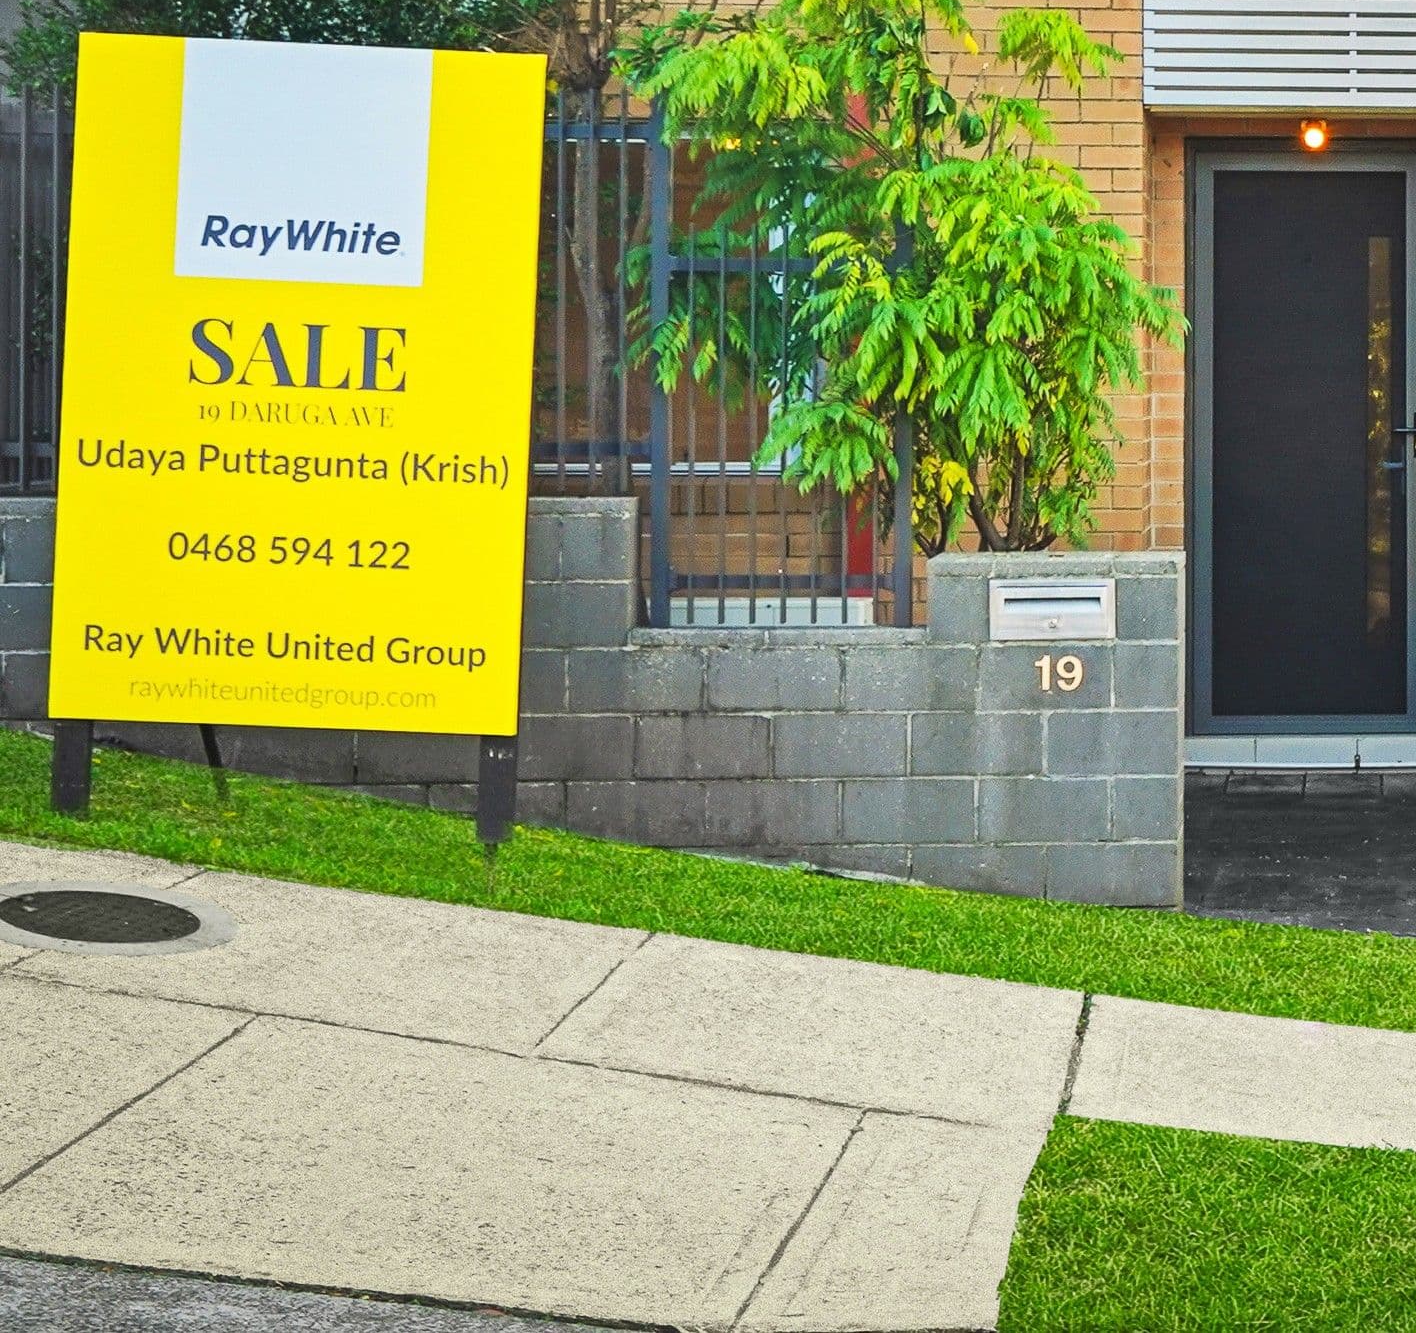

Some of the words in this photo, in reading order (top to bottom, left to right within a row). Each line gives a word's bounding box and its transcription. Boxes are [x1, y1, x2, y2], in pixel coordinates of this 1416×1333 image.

[188, 317, 407, 393] SALE
[199, 404, 221, 423] 19
[230, 400, 338, 426] DARUGA
[345, 406, 394, 428] AVE
[77, 437, 186, 477] Udaya
[199, 443, 388, 484] Puttagunta
[400, 450, 509, 491] (Krish)
[167, 531, 257, 564] 0468
[268, 535, 335, 567] 594
[347, 539, 411, 570] 122
[83, 623, 145, 660] Ray
[154, 626, 255, 658] White
[266, 631, 375, 663] United
[385, 636, 487, 673] Group
[1034, 654, 1084, 692] 19
[129, 677, 436, 710] raywhiteunitedgroup.com
